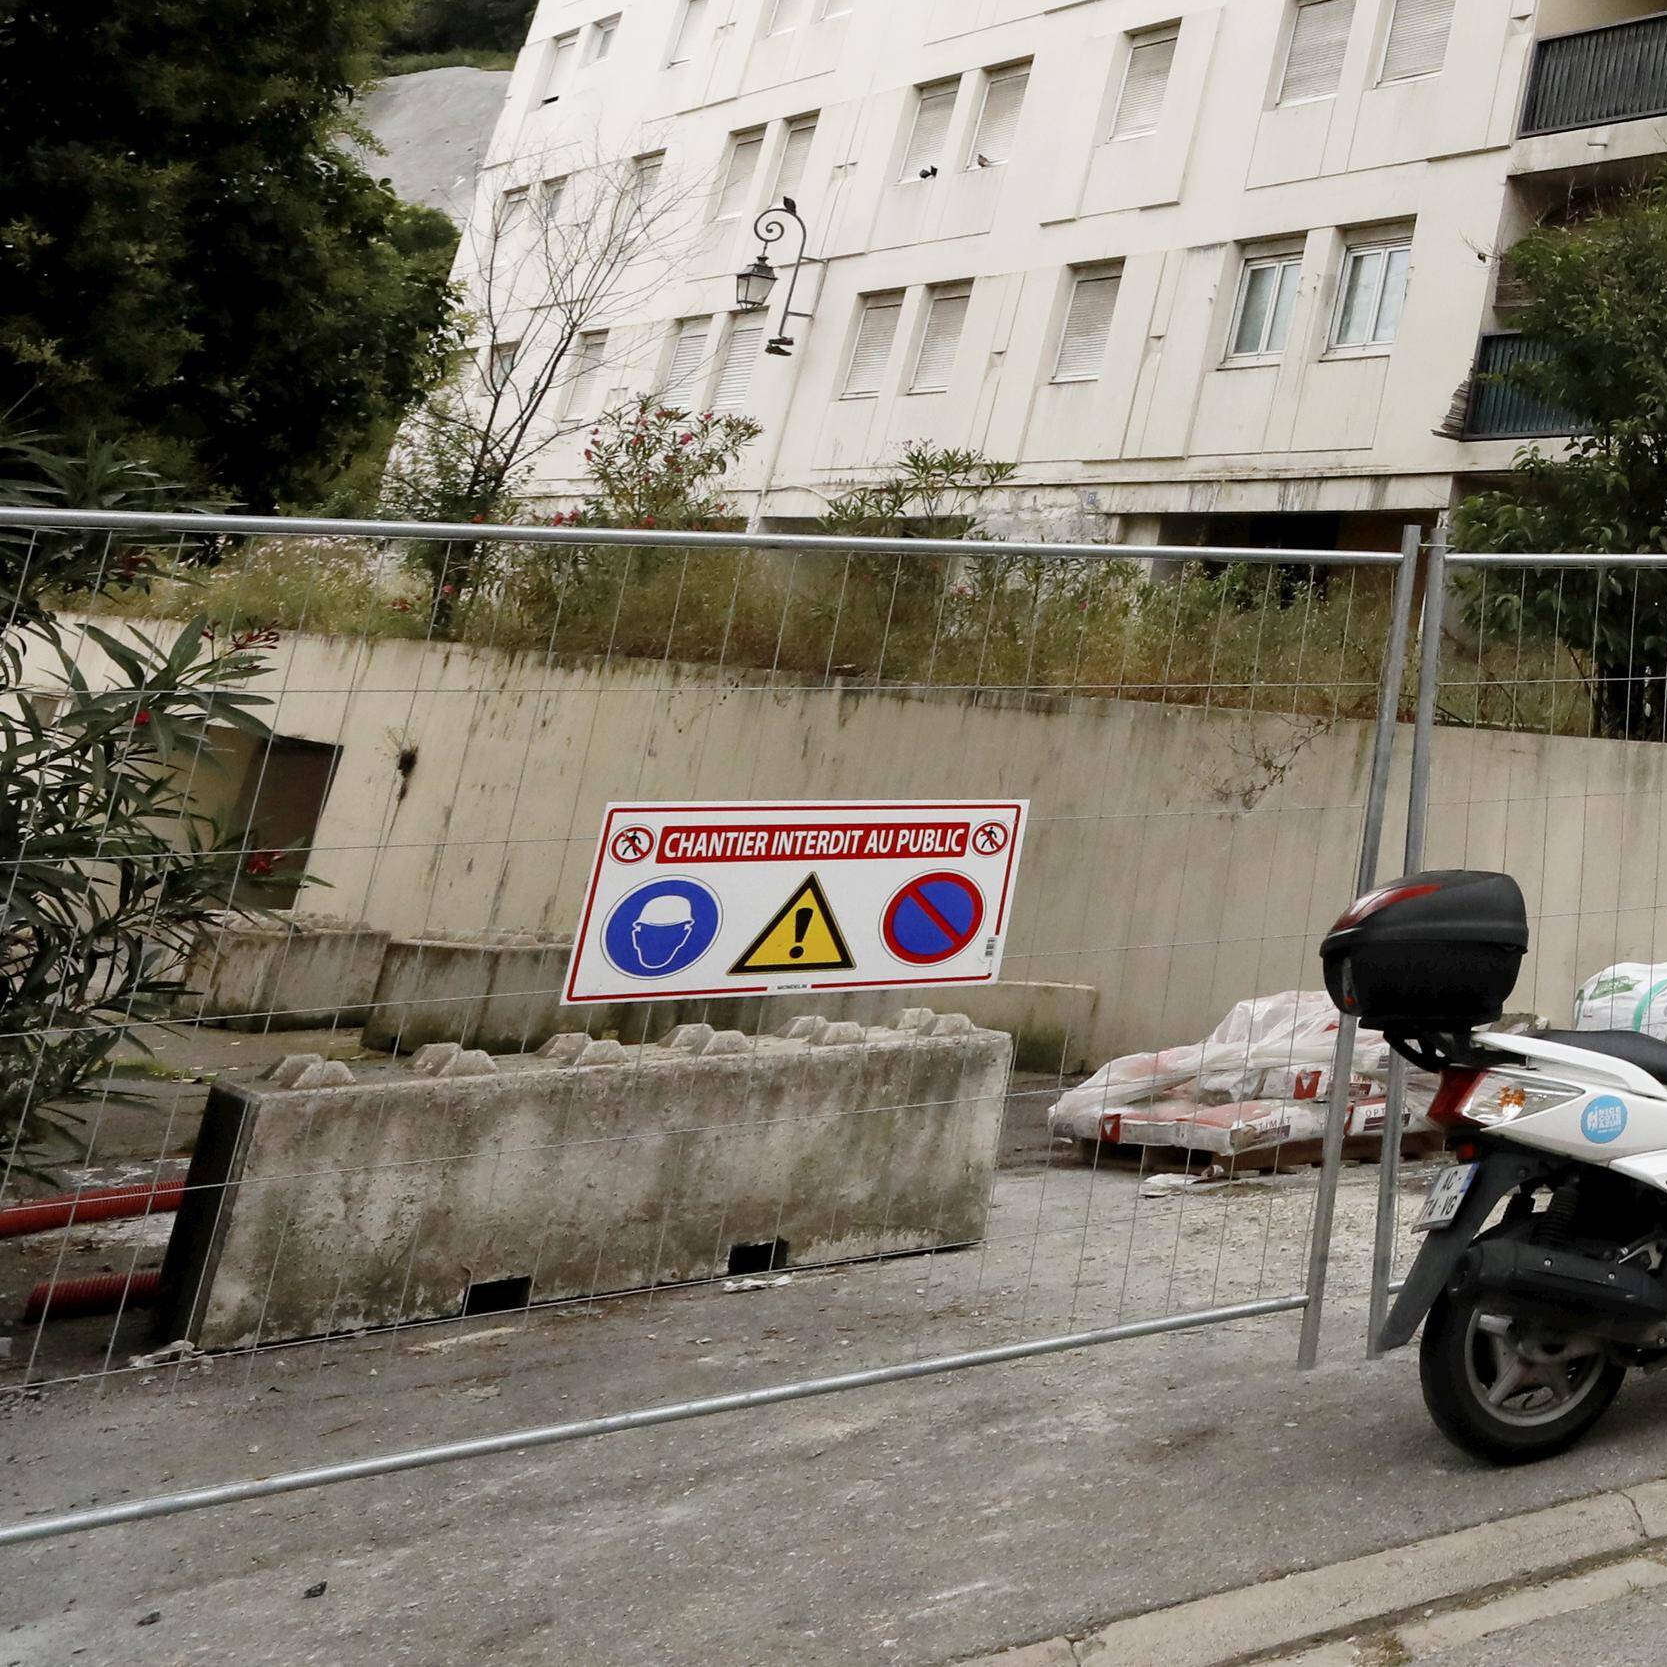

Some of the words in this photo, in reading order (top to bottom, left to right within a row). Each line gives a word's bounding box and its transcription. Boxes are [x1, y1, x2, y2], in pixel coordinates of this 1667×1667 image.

[664, 831, 769, 859] CHANTIER
[771, 829, 865, 857] INTERDIT
[864, 829, 895, 854] AU
[896, 827, 966, 853] PUBLIC
